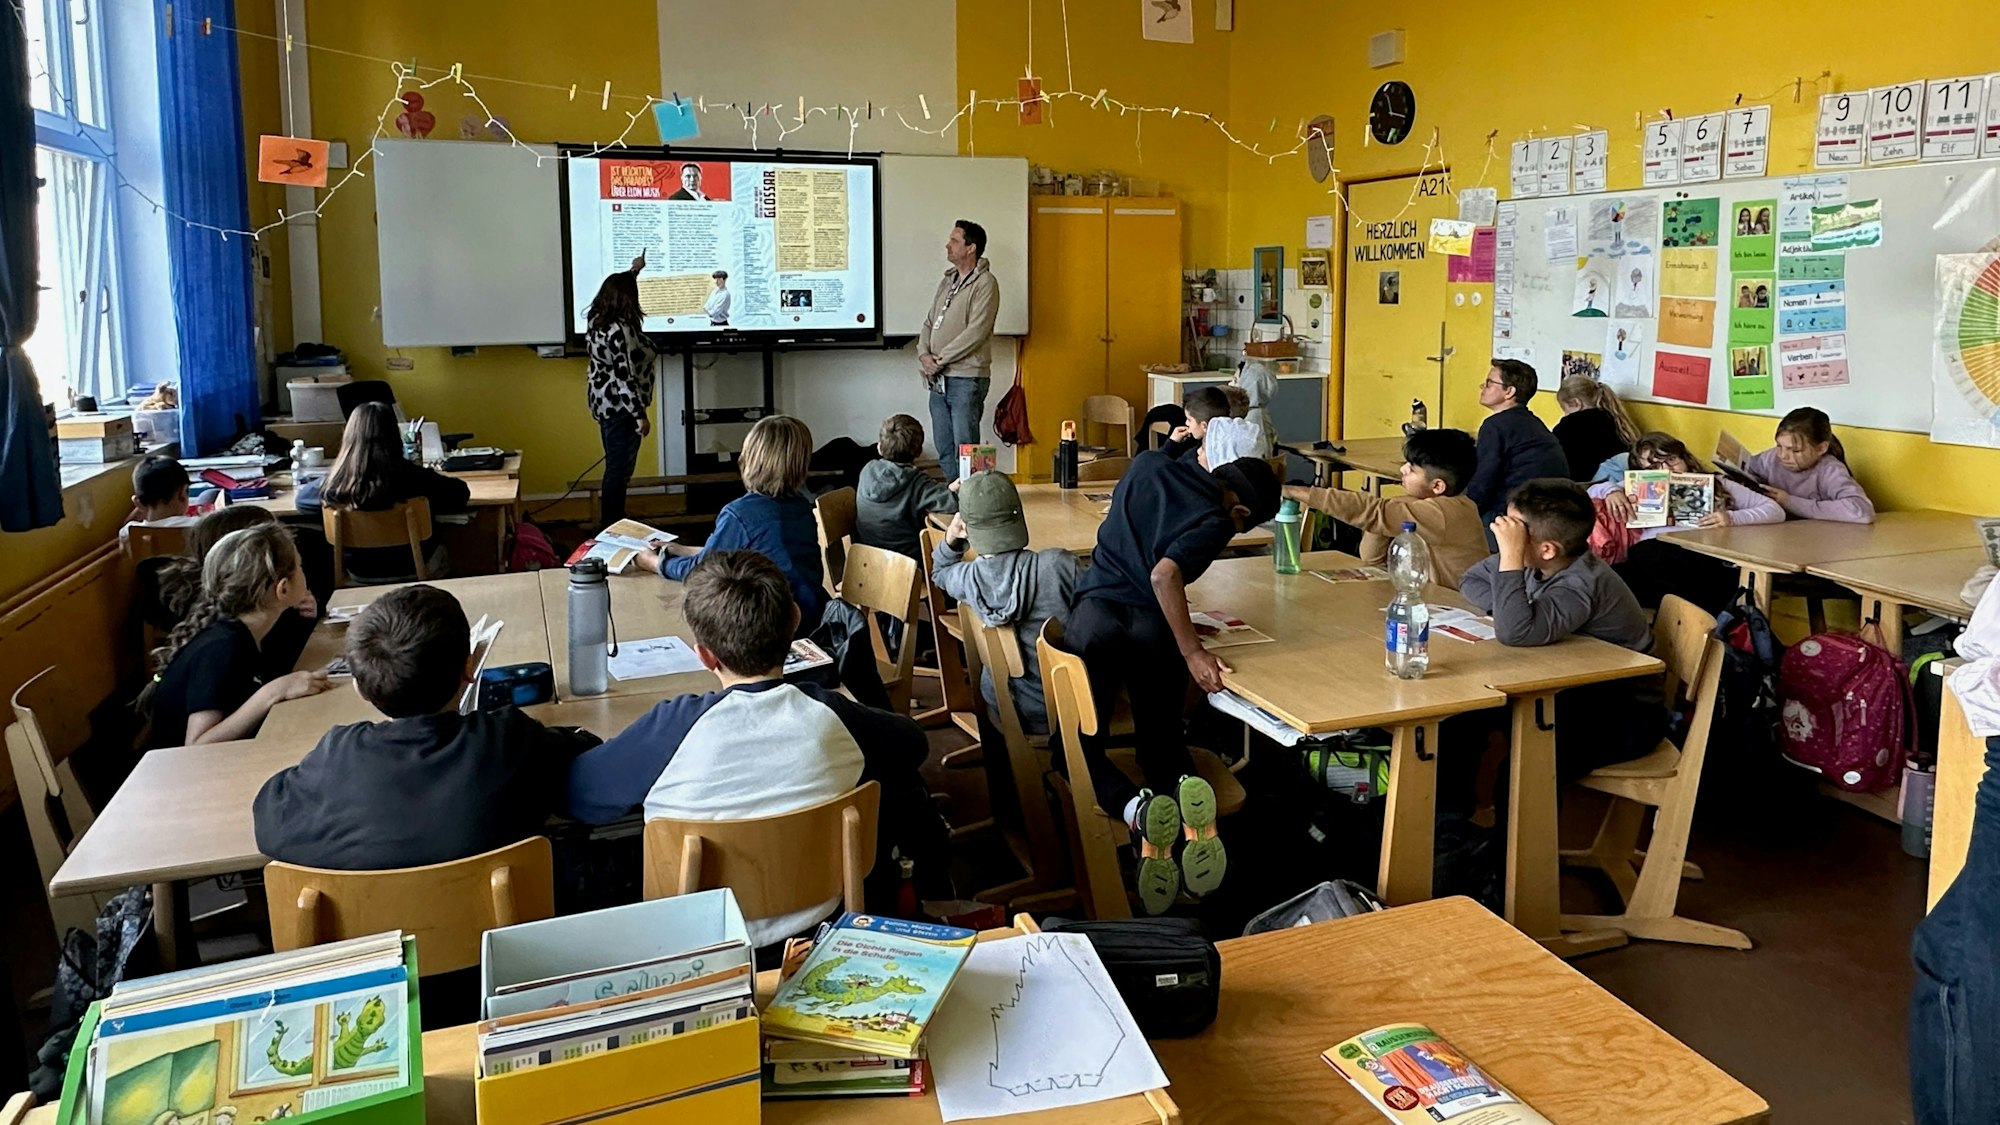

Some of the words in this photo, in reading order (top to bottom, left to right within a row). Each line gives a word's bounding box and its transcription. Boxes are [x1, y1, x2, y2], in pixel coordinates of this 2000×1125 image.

[1881, 86, 1912, 115] 10
[1938, 82, 1970, 110] 11
[1836, 96, 1850, 122] 9
[1696, 119, 1708, 140] 6
[1742, 112, 1753, 134] 7
[1657, 125, 1668, 146] 5
[1522, 144, 1529, 162] 1
[1550, 141, 1560, 160] 2
[1586, 137, 1594, 156] 3
[1882, 147, 1904, 157] Zehn
[1941, 143, 1956, 154] Elf
[1828, 153, 1848, 162] Neun
[1691, 168, 1709, 176] Sechs
[1734, 163, 1755, 172] Sieben
[627, 186, 642, 198] ELON
[763, 171, 776, 218] GLOSSAR
[1790, 192, 1816, 201] Artikel
[1366, 220, 1417, 240] HERZLICH
[1354, 242, 1425, 262] WILLKOMMEN
[1665, 260, 1699, 272] Ermahnung
[1784, 298, 1808, 307] Nomen
[1787, 353, 1813, 362] Verben
[1658, 360, 1689, 375] Auszeit
